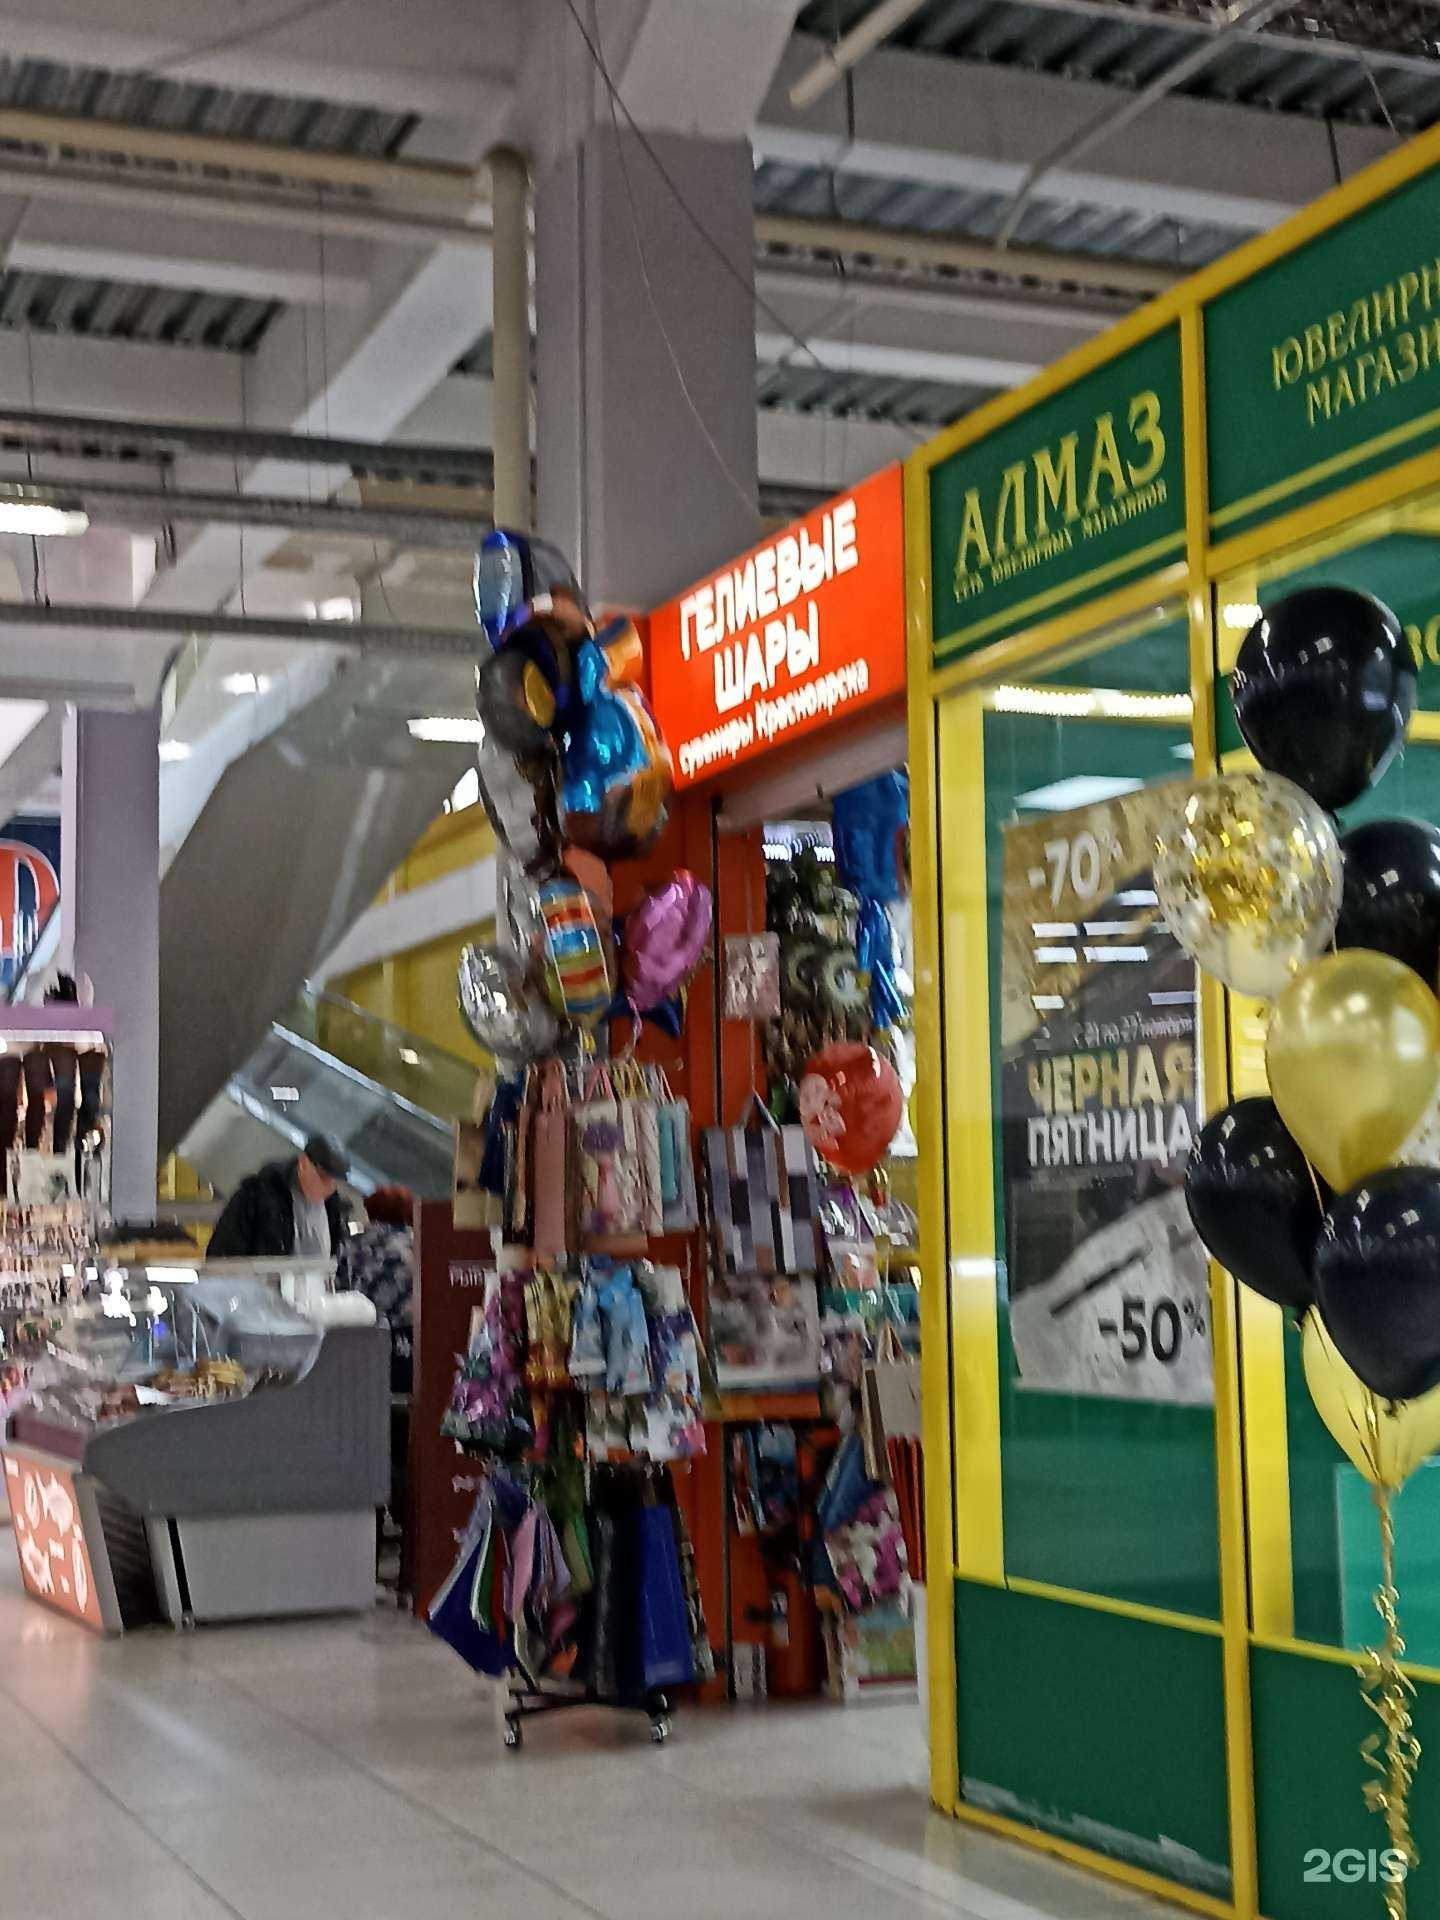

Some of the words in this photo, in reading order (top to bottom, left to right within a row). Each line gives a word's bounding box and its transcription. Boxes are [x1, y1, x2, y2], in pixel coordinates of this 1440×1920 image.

[955, 390, 1166, 577] АЛМАЗ
[679, 498, 859, 662] ГЕЛИЕВЫЕ
[714, 600, 819, 713] ШАРЫ
[1027, 1043, 1193, 1118] ЧЕРНАЯ
[1028, 1104, 1193, 1168] ПЯТНИЦА
[1098, 1296, 1206, 1363] -50%
